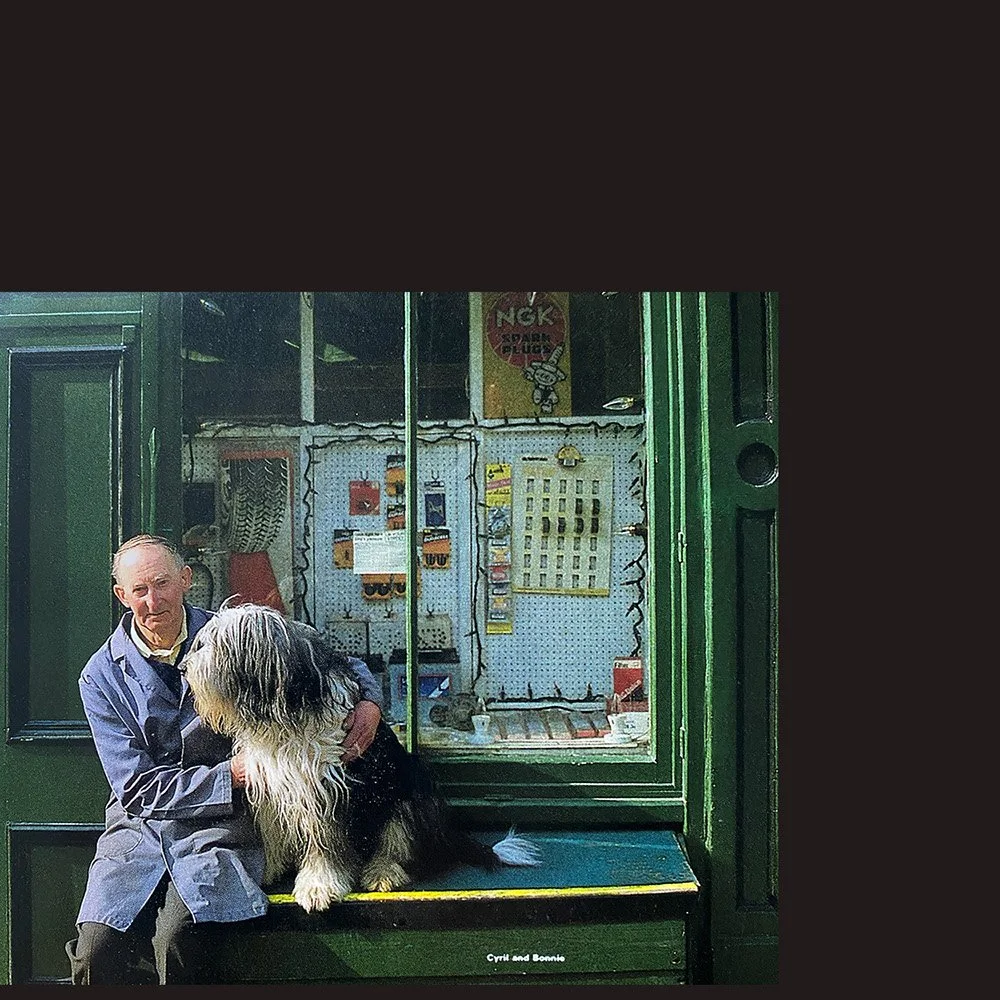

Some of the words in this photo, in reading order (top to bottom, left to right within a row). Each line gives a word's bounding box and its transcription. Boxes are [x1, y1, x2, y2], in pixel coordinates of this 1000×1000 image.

[495, 305, 554, 328] NGK
[486, 953, 510, 963] Cyril
[512, 954, 530, 962] and
[532, 953, 565, 962] Bonnie
